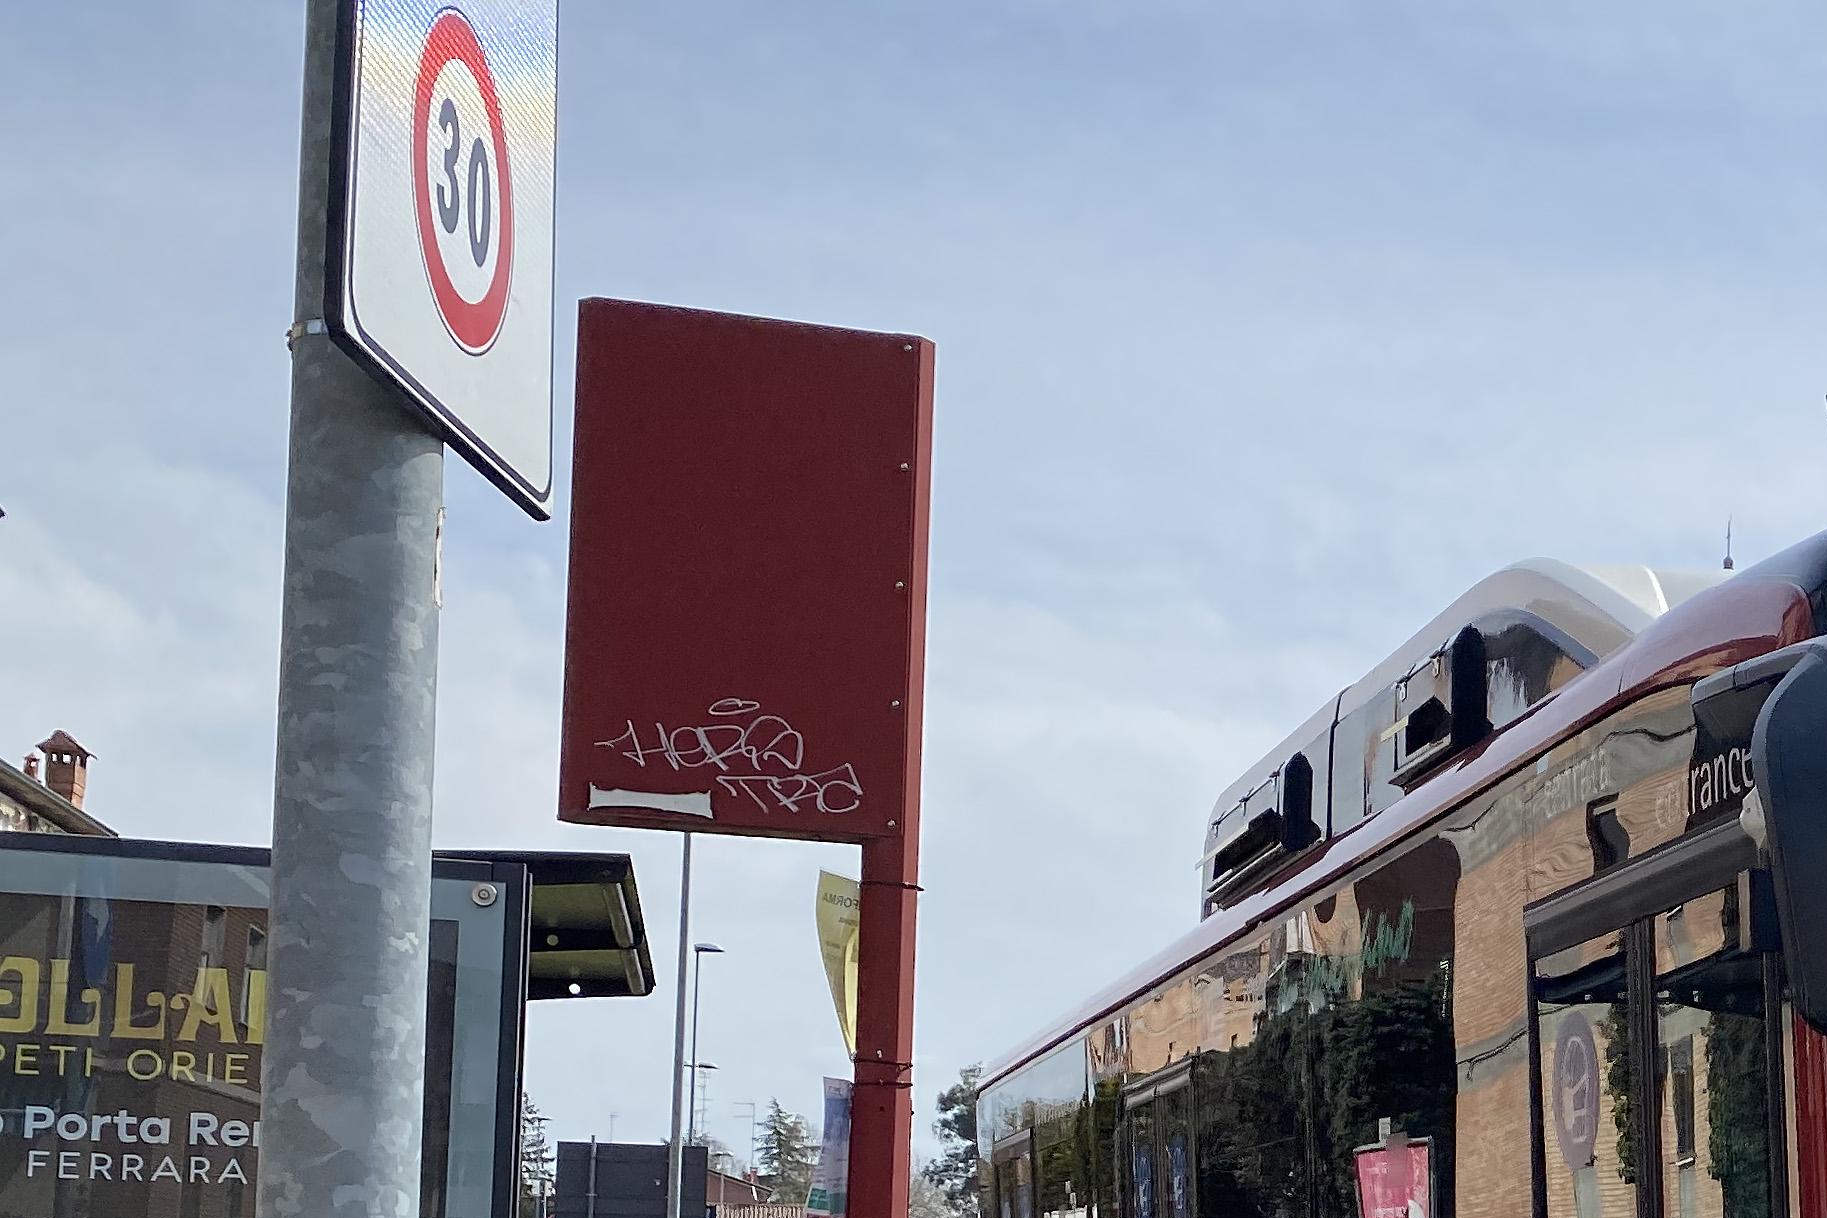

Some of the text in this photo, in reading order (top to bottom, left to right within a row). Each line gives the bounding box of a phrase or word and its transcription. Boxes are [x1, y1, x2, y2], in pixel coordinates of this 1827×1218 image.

[436, 98, 491, 268] 30
[0, 1043, 94, 1077] ETI
[23, 1105, 170, 1145] Porta
[27, 1150, 248, 1185] FERRARA
